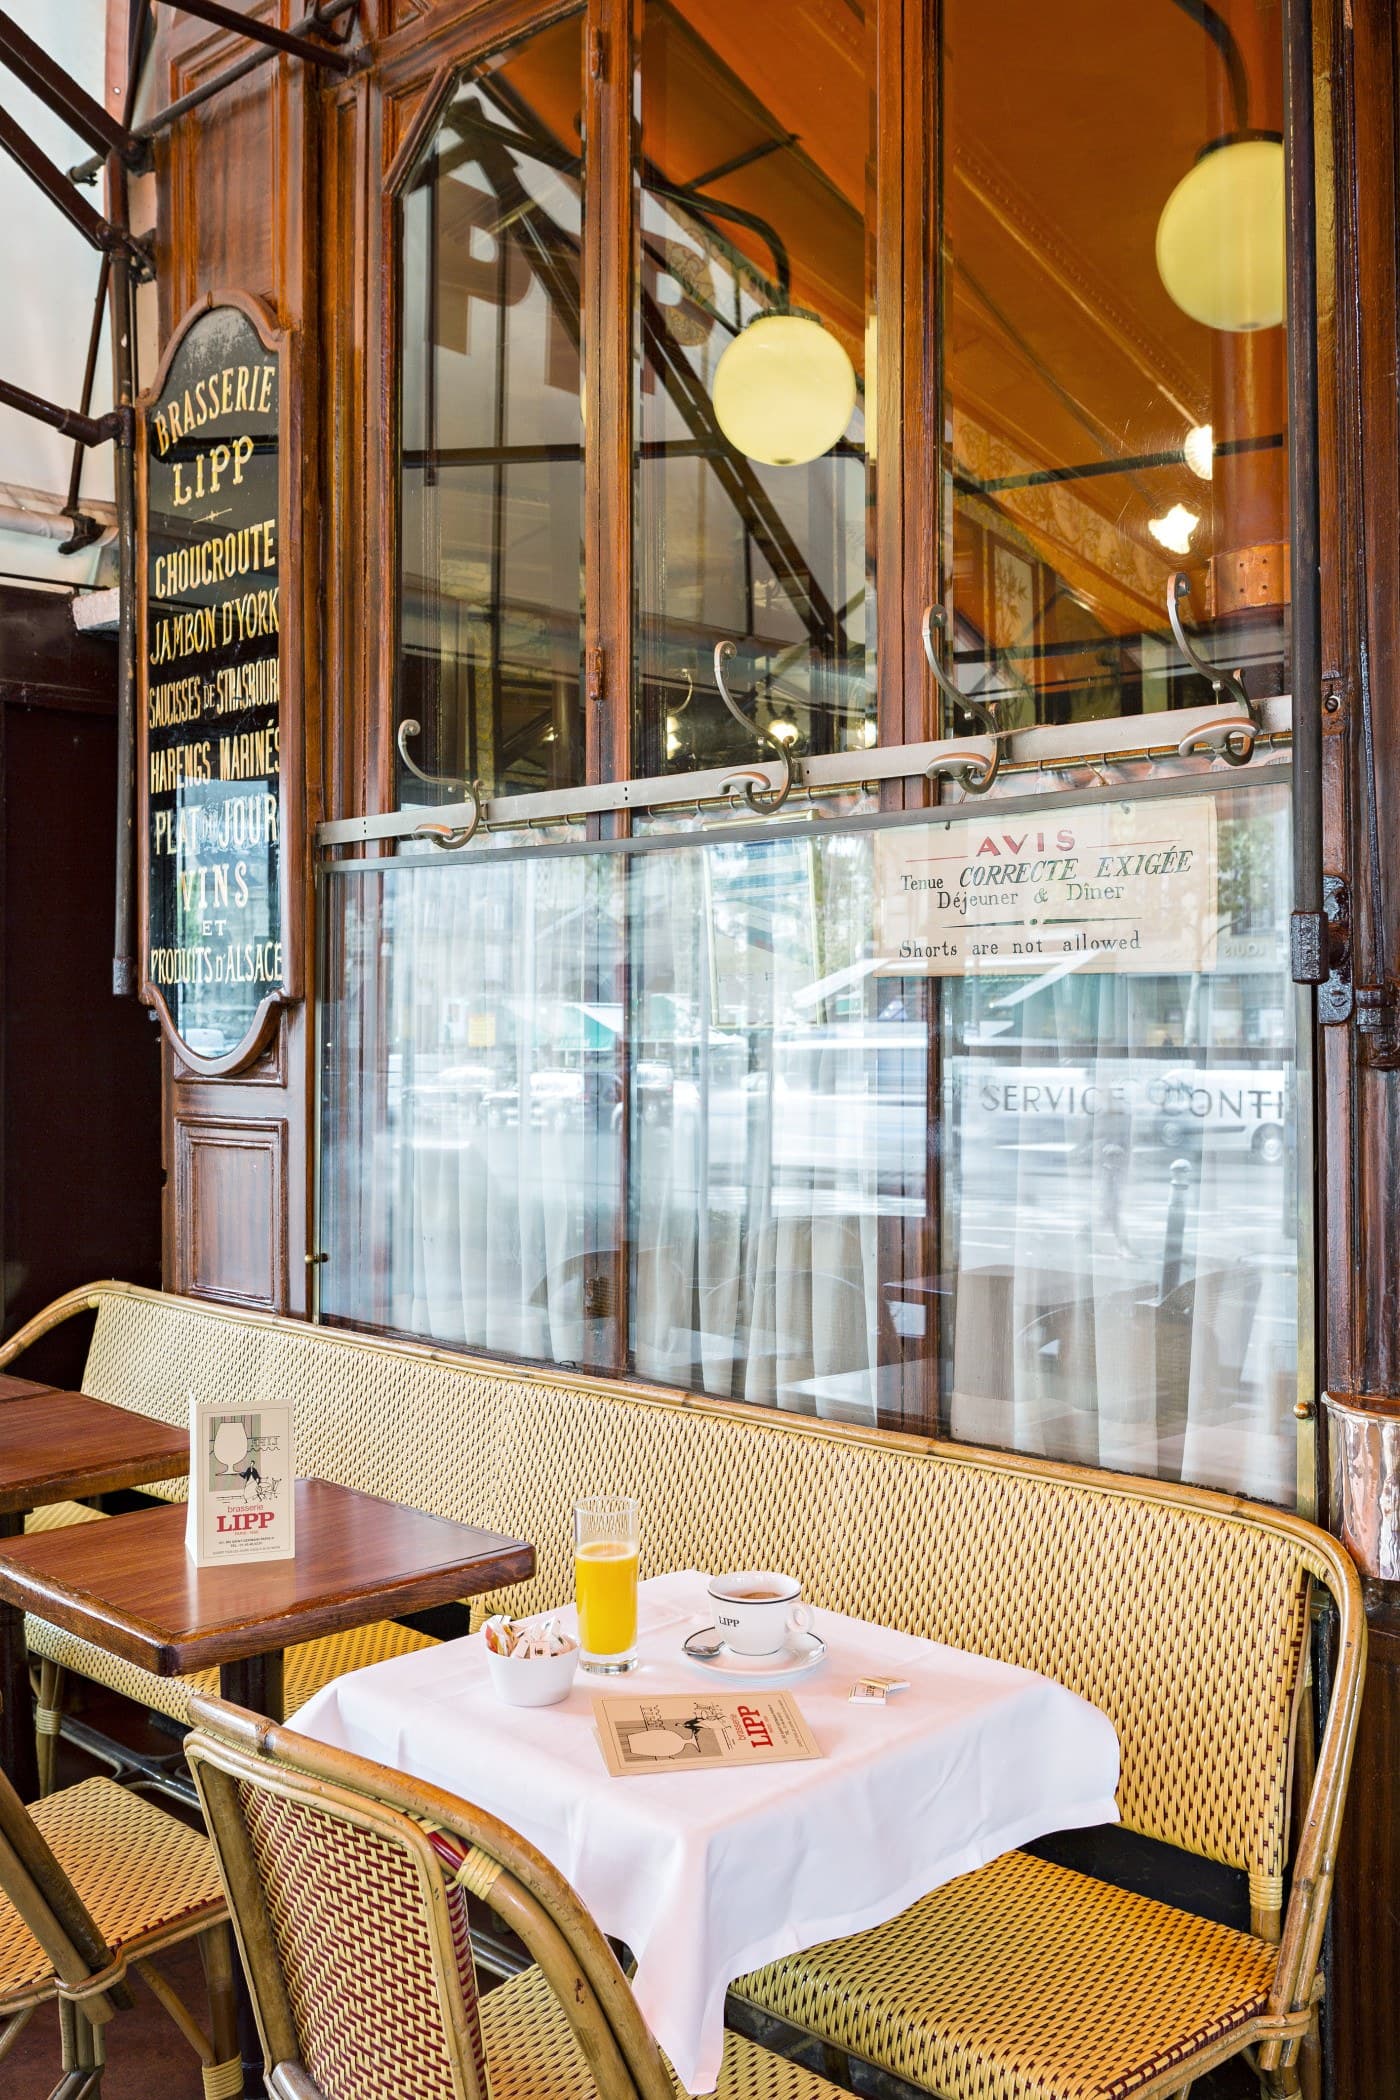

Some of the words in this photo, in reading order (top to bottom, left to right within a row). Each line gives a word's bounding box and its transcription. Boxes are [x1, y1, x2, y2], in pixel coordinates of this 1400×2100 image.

[154, 365, 276, 456] BRASSERIE
[172, 434, 255, 507] LIPP
[154, 519, 276, 600] CHOUCROUTE
[150, 604, 217, 666] JAMBON
[222, 586, 280, 646] D'YORK
[149, 675, 201, 729] SAUCISSES
[150, 740, 211, 795] HARENGS
[154, 805, 202, 855] PLAT
[218, 791, 278, 849] JOUR
[976, 829, 1076, 857] AVIS
[179, 860, 250, 914] VINS
[900, 874, 944, 891] Tenue
[959, 857, 1079, 888] CORRECTE
[1094, 845, 1194, 879] EXIGÉE
[937, 891, 1019, 915] Déjeuner
[1033, 887, 1049, 905] &
[1066, 882, 1126, 901] Dîner
[202, 919, 227, 937] ET
[899, 940, 958, 958] Shorts
[972, 943, 999, 956] are
[1012, 940, 1043, 954] not
[1062, 930, 1142, 952] allowed
[151, 946, 213, 986] PRODUITS
[981, 1084, 1126, 1116] SERVICE
[216, 1511, 275, 1532] LIPP
[227, 1504, 265, 1513] brasserie
[718, 1615, 740, 1628] LIPP
[737, 1705, 774, 1748] LIPP
